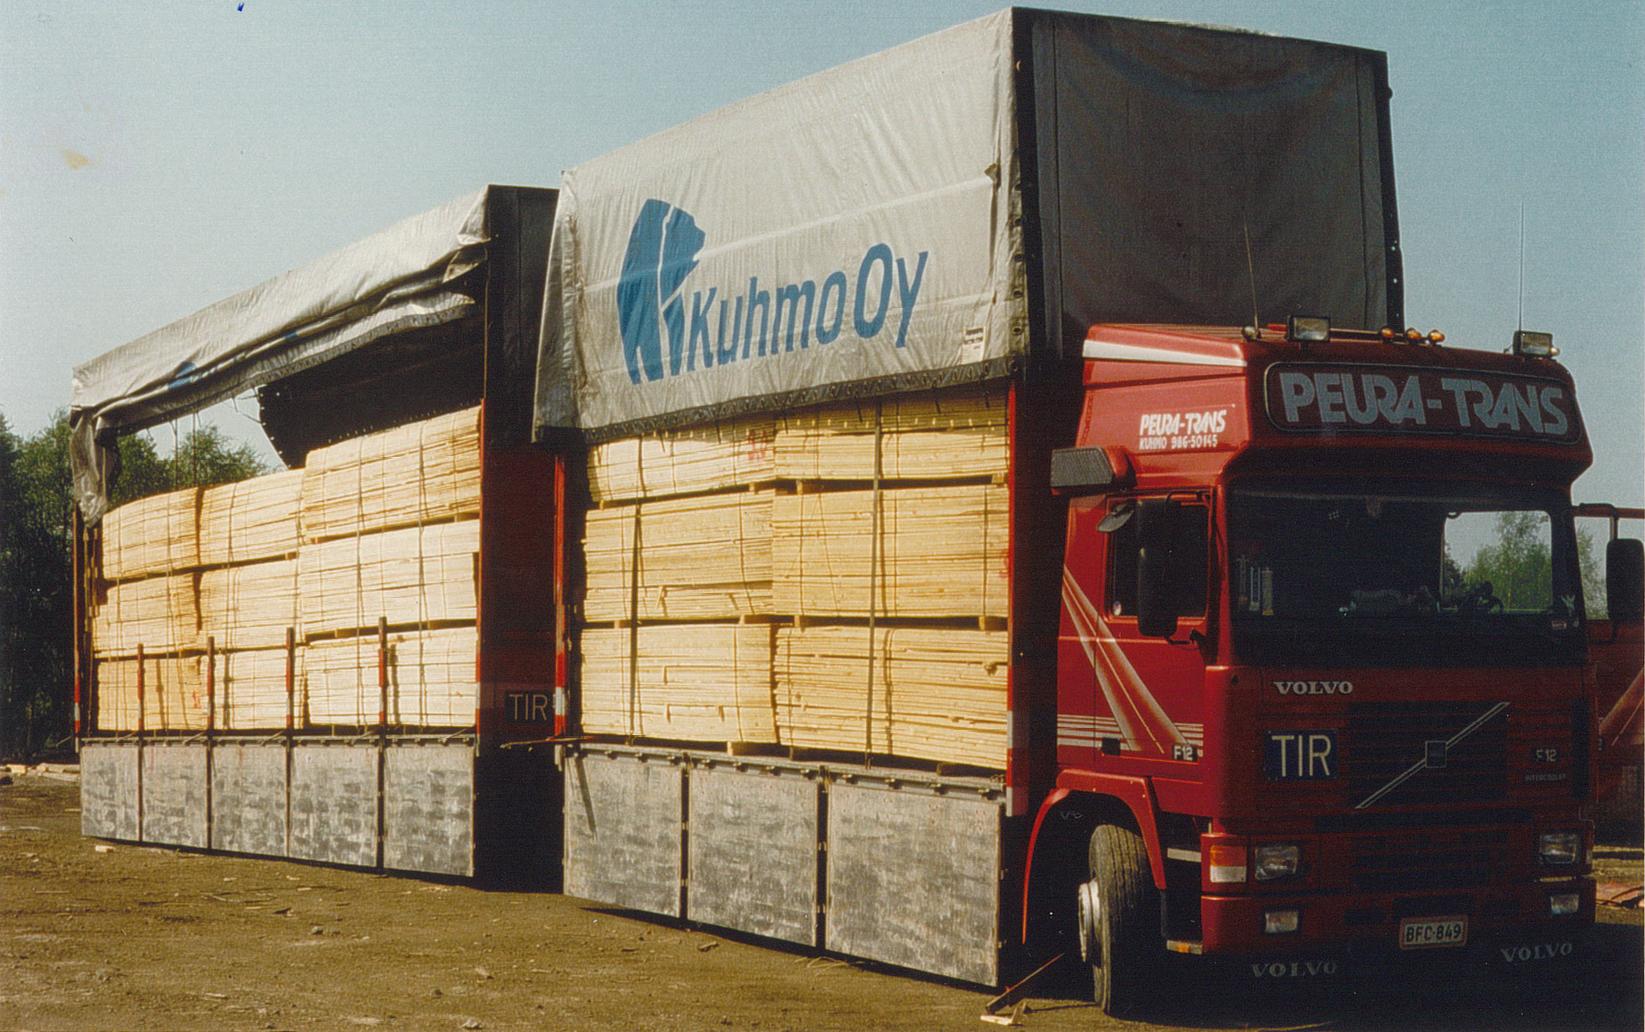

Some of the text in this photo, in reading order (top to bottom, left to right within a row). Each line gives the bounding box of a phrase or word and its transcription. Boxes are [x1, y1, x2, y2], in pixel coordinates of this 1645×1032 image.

[687, 243, 929, 372] Kuhmo Oy
[1279, 372, 1569, 436] PEURA-TRANS
[1139, 409, 1228, 436] PEURA-TRANS
[1138, 437, 1168, 450] KUHMO
[1272, 680, 1354, 696] VOLVO
[508, 693, 549, 721] TIR
[1173, 745, 1194, 762] F12
[1271, 734, 1333, 777] TIR
[1534, 748, 1558, 763] F12
[1405, 922, 1462, 943] BFC-849
[1500, 943, 1574, 964] VOLVO
[1251, 961, 1338, 978] VOLVO
